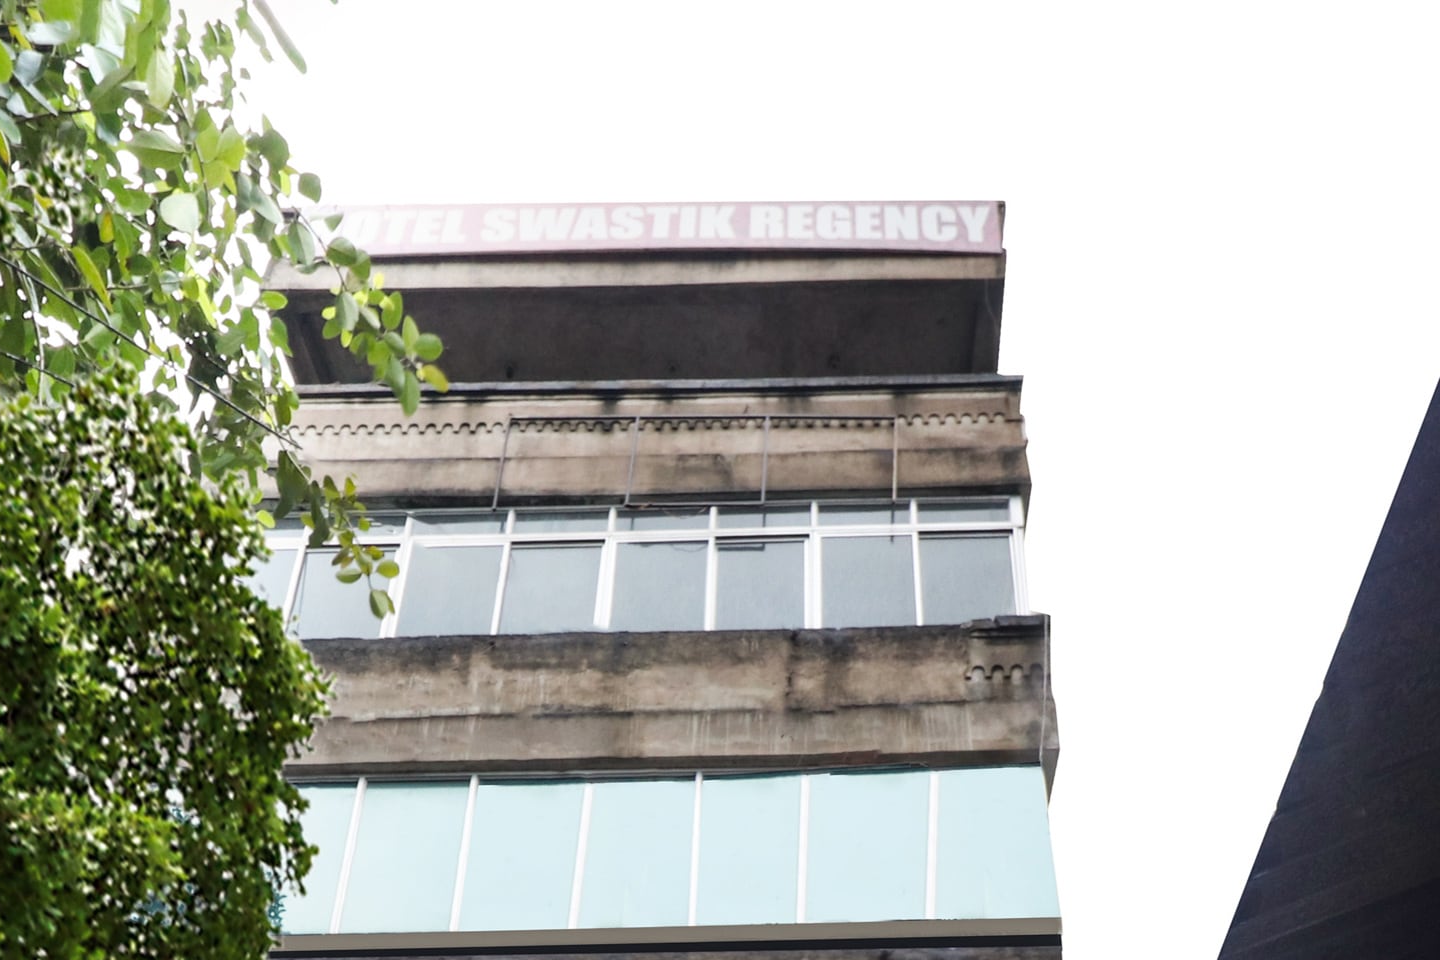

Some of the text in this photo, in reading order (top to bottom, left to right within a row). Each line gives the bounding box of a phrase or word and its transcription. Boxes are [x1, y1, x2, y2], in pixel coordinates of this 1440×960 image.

[344, 204, 990, 246] OTEL SWASTIK REGENCY
